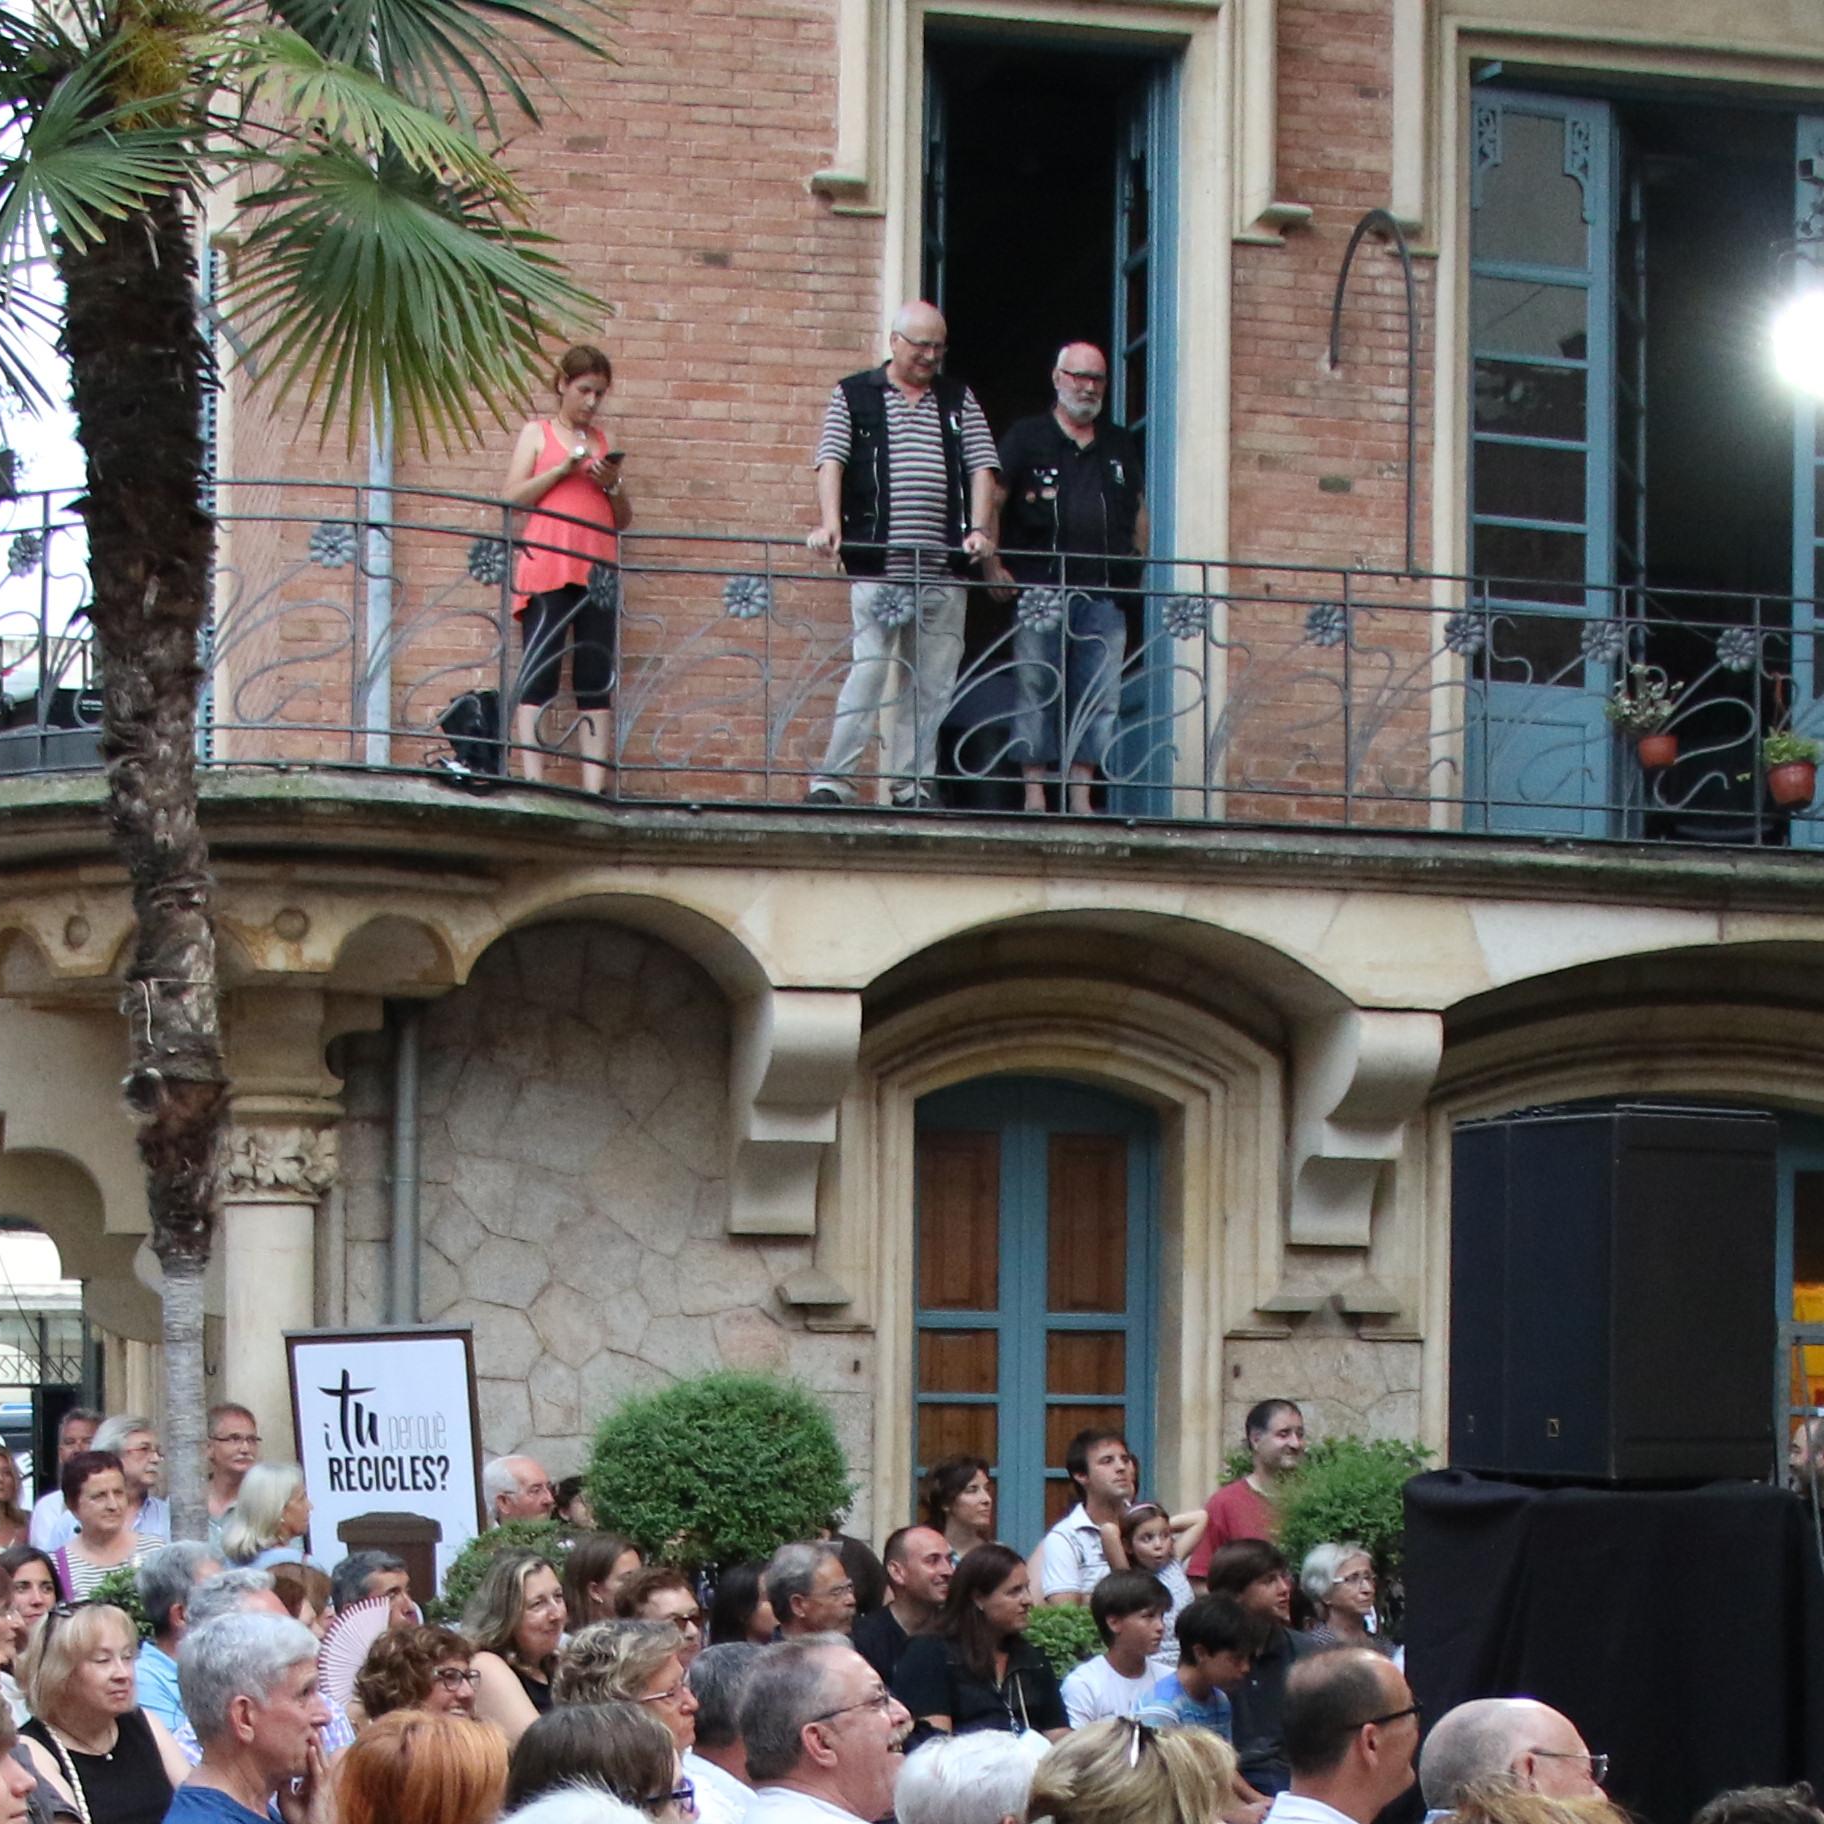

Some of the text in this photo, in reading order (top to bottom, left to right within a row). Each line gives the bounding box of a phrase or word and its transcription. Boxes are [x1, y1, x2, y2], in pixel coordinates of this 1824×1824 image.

[323, 1422, 334, 1451] i
[388, 1415, 413, 1453] per
[415, 1410, 447, 1453] què
[328, 1455, 450, 1492] RECICLES?
